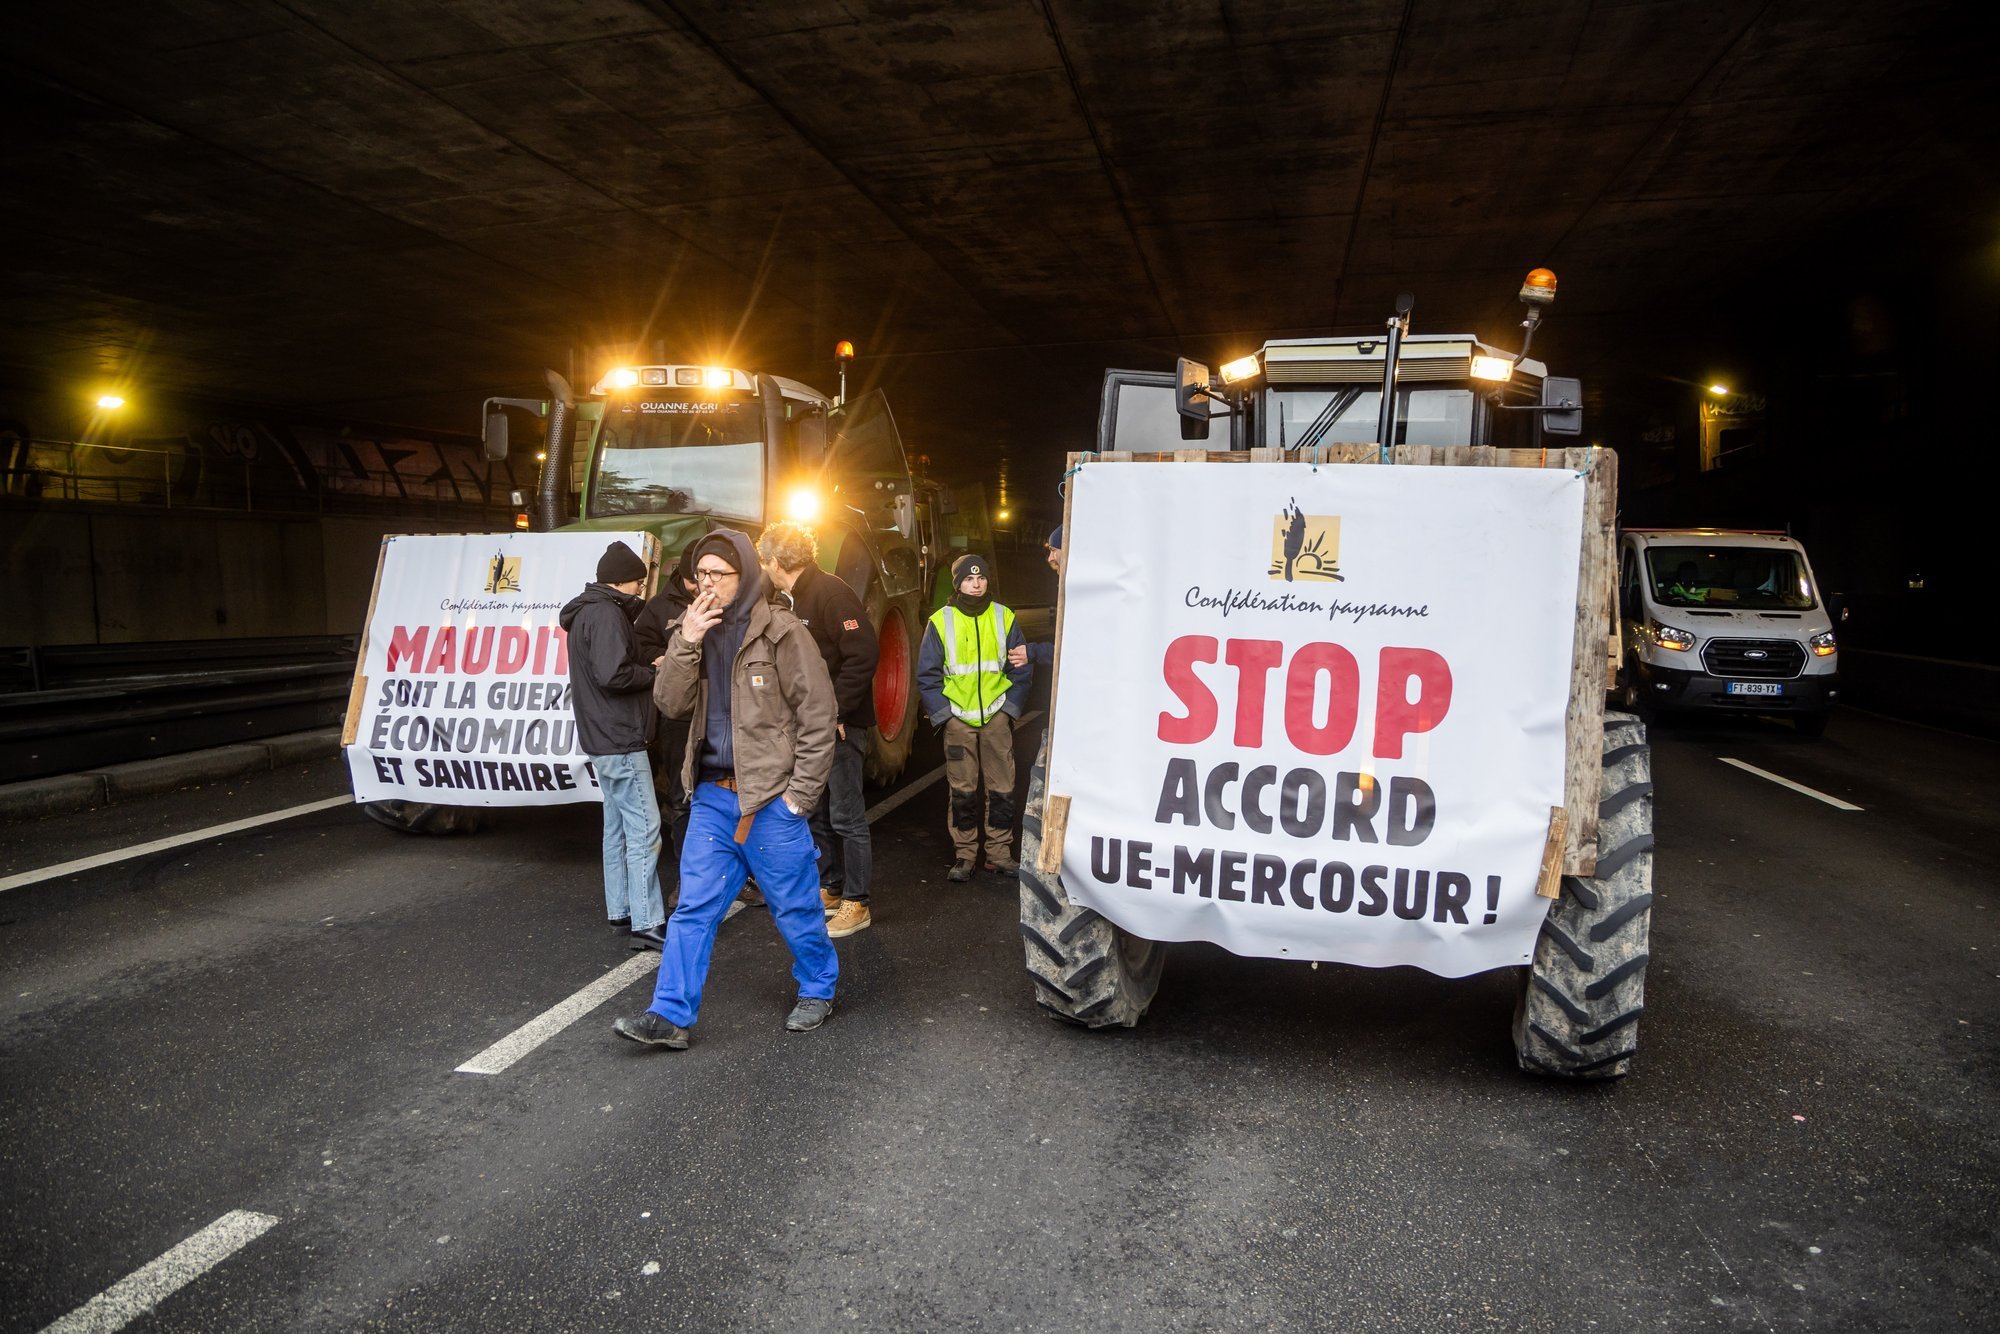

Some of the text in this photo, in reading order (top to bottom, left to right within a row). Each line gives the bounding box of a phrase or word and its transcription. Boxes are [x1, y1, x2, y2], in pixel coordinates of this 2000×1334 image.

[640, 402, 718, 410] OUANNE AGRI
[440, 598, 561, 614] Confédération paysanne
[1185, 585, 1429, 623] Confédération paysanne
[378, 680, 437, 707] SOIT
[444, 681, 475, 709] LA
[1157, 635, 1453, 759] STOP
[1734, 684, 1775, 693] FT-839-YX
[369, 709, 587, 756] ÉCONOMIQU
[372, 755, 600, 791] ET SANITAIRE !
[1154, 757, 1436, 848] ACCORD
[1090, 836, 1501, 925] UE-MERCOSUR !
